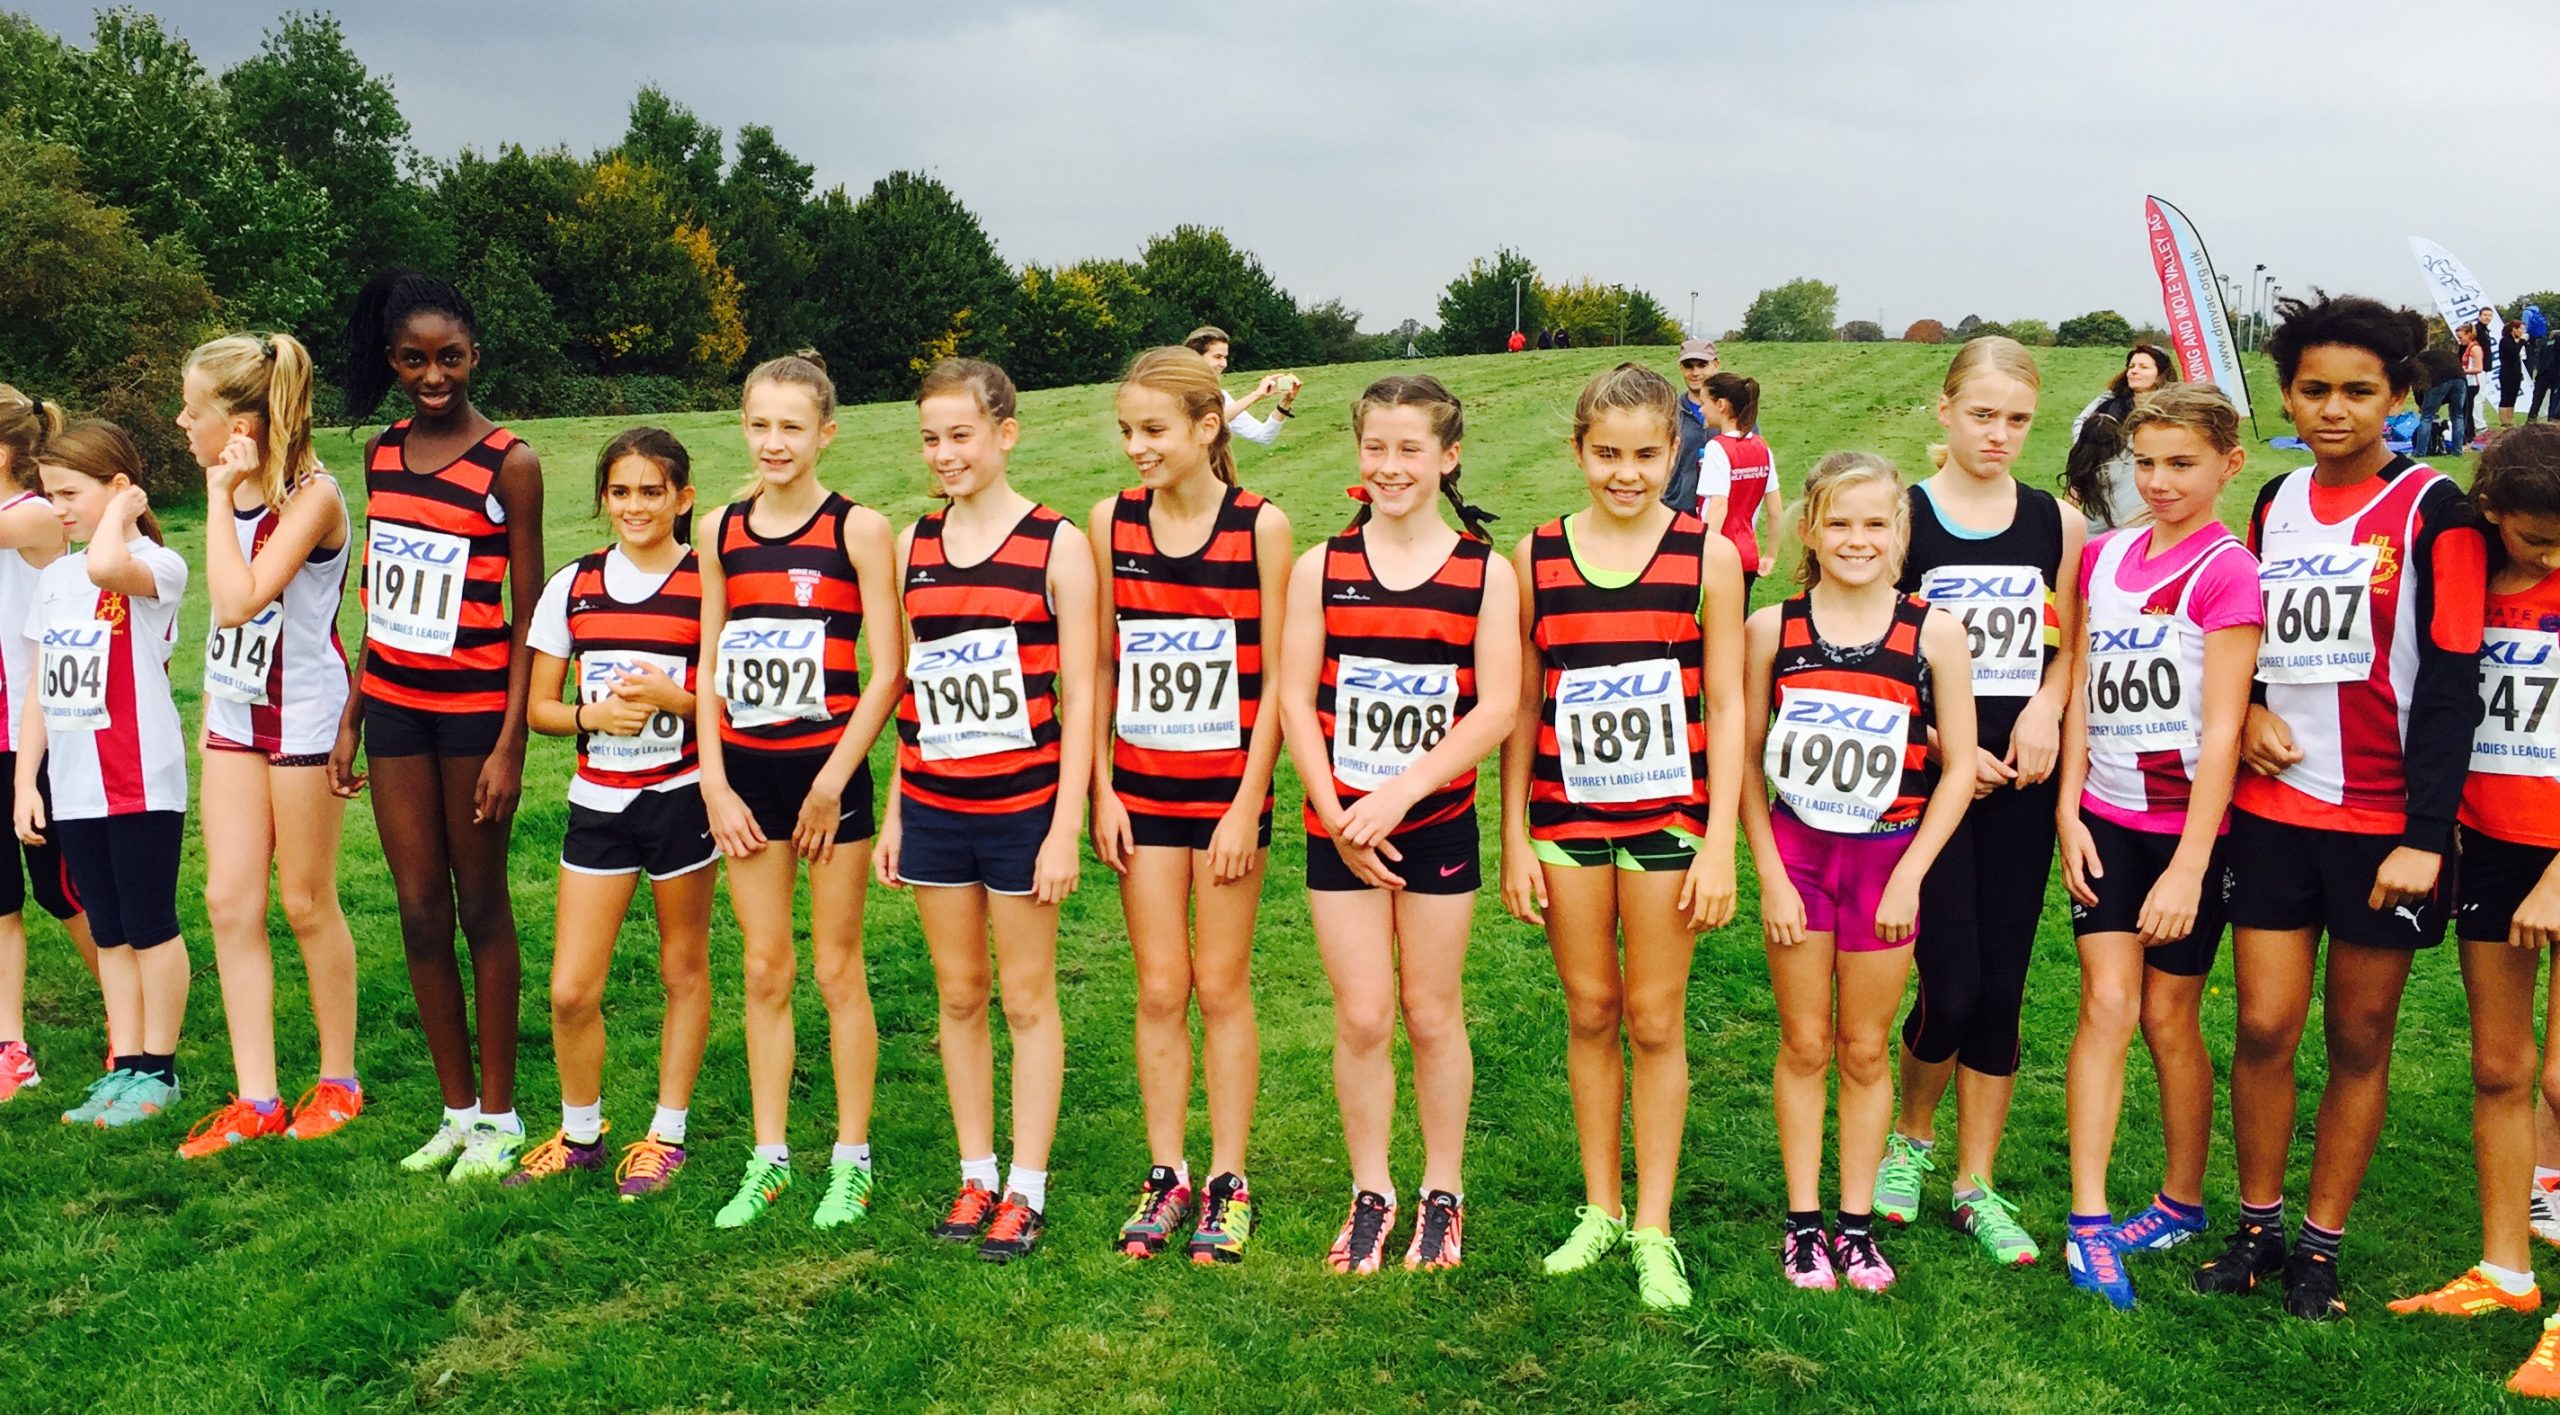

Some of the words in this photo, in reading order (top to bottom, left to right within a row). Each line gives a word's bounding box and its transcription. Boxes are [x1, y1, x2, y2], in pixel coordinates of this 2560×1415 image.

[2147, 213, 2165, 232] AC
[2154, 236, 2179, 280] VALLEY
[2167, 282, 2191, 320] MOLE
[2190, 249, 2232, 372] www.dmvac.org.uk
[2178, 319, 2199, 347] AND
[373, 532, 461, 565] 2XU
[2260, 554, 2369, 580] 2XU
[375, 560, 453, 620] 1911
[1926, 577, 2036, 599] 2XU
[2262, 585, 2365, 645] 1607
[416, 626, 452, 642] LEAGUE
[722, 630, 816, 649] 2XU
[1126, 629, 1226, 653] 2XU
[1936, 607, 2037, 659] 692
[2089, 625, 2169, 653] 2XU
[914, 638, 1007, 672] 2XU
[2287, 654, 2324, 668] LADIES
[2326, 652, 2372, 665] LEAGUE
[2480, 640, 2552, 666] XU
[726, 657, 817, 707] 1892
[1131, 660, 1232, 713] 1897
[1343, 666, 1449, 697] 2XU
[1562, 670, 1672, 704] 2XU
[2006, 668, 2037, 681] LEAGUE
[2088, 657, 2181, 714] 1660
[921, 668, 1019, 725] 1905
[1121, 725, 1158, 735] SURREY
[1161, 724, 1195, 735] LADIES
[1198, 721, 1235, 733] LEAGUE
[1348, 697, 1447, 754] 1908
[1785, 700, 1900, 735] 2XU
[2110, 724, 2143, 736] LADIES
[2146, 720, 2189, 735] LEAGUE
[1569, 703, 1676, 766] 1891
[1338, 756, 1369, 773] SURREY
[1779, 731, 1897, 798] 1909
[2512, 745, 2557, 759] LEAGUE
[1568, 775, 1607, 787] SURREY
[1647, 766, 1687, 782] LEAGUE
[1806, 799, 1845, 814] LADIES
[1847, 804, 1883, 821] LEAGU
[1872, 821, 1897, 833] IKE
